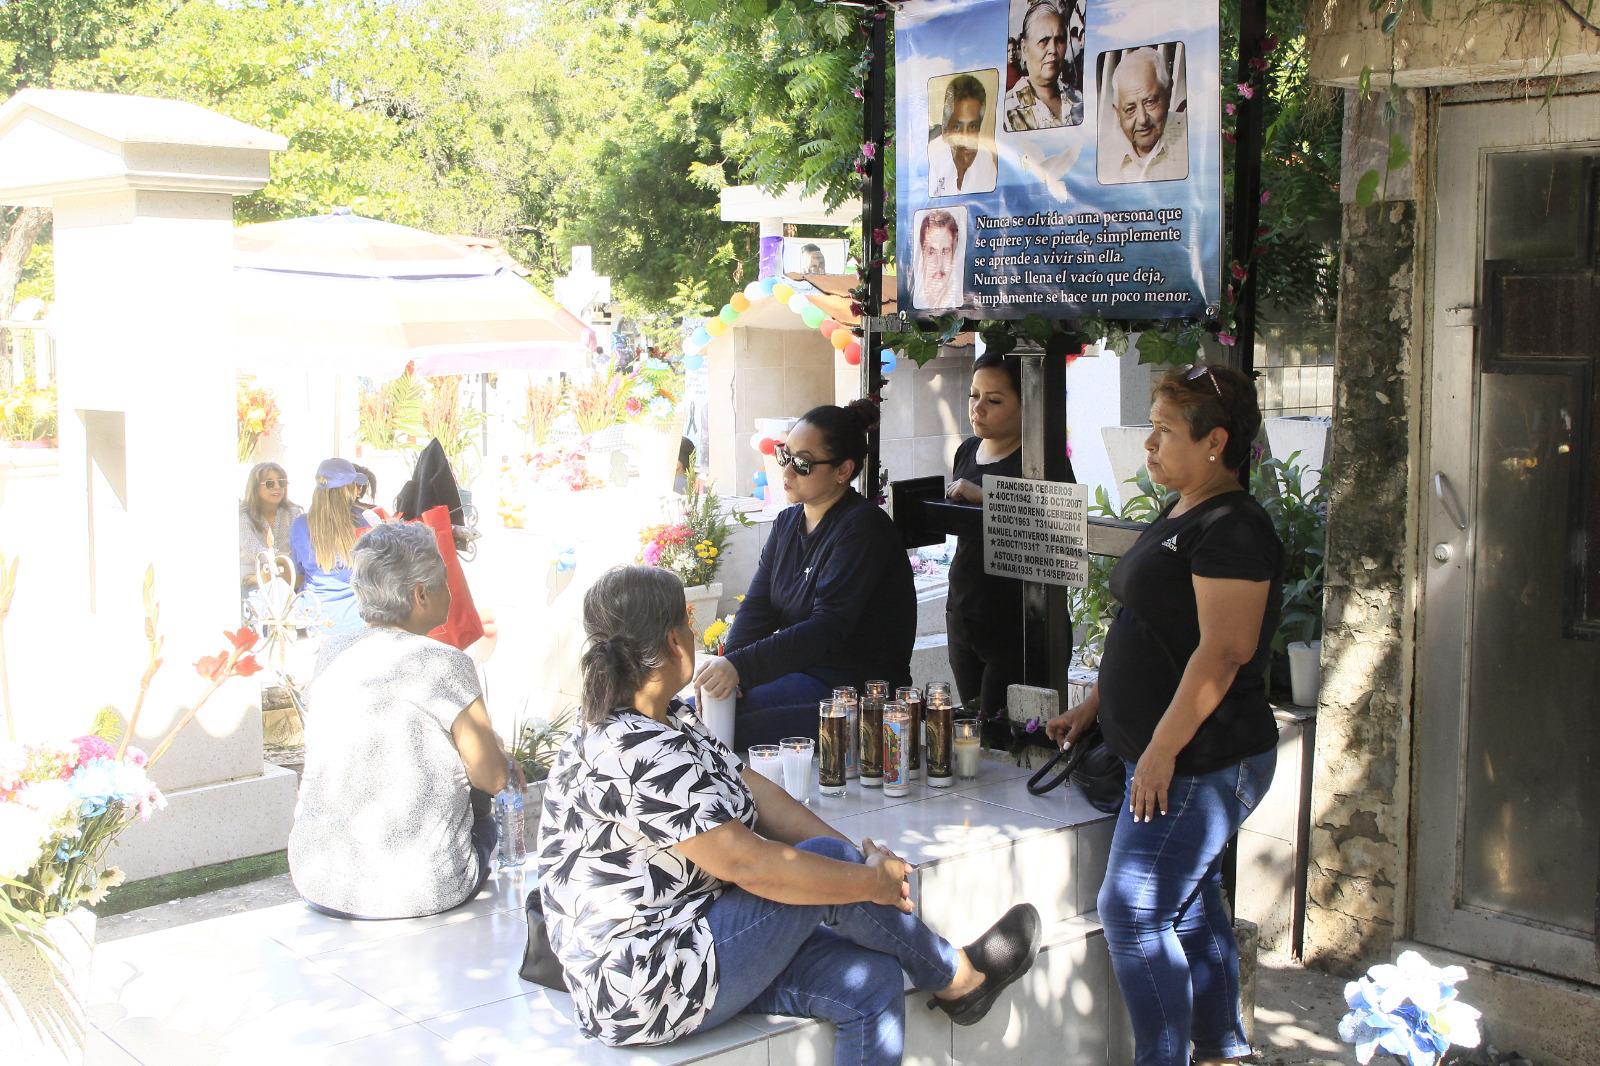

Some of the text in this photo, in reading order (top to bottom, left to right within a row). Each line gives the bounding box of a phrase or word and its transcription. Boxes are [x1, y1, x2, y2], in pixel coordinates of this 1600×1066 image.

[976, 209, 1182, 229] Nunca se olvida a una persona que
[975, 228, 1180, 250] se quiere y se pierde, simplemente
[974, 250, 1124, 269] se aprende a vivir sin ella.
[974, 268, 1165, 287] Nunca se llena el vacío que deja,
[973, 289, 1191, 309] simplemente se hace un poco menor.
[997, 481, 1072, 496] FRANCISCA CEBREROS
[989, 503, 1082, 521] GUSTAVO MORENO CEBREROS
[988, 526, 1083, 546] MANUEL ONTIVEROS MARTINEZ
[994, 552, 1079, 570] ASTOLFO MORENO PEREZ
